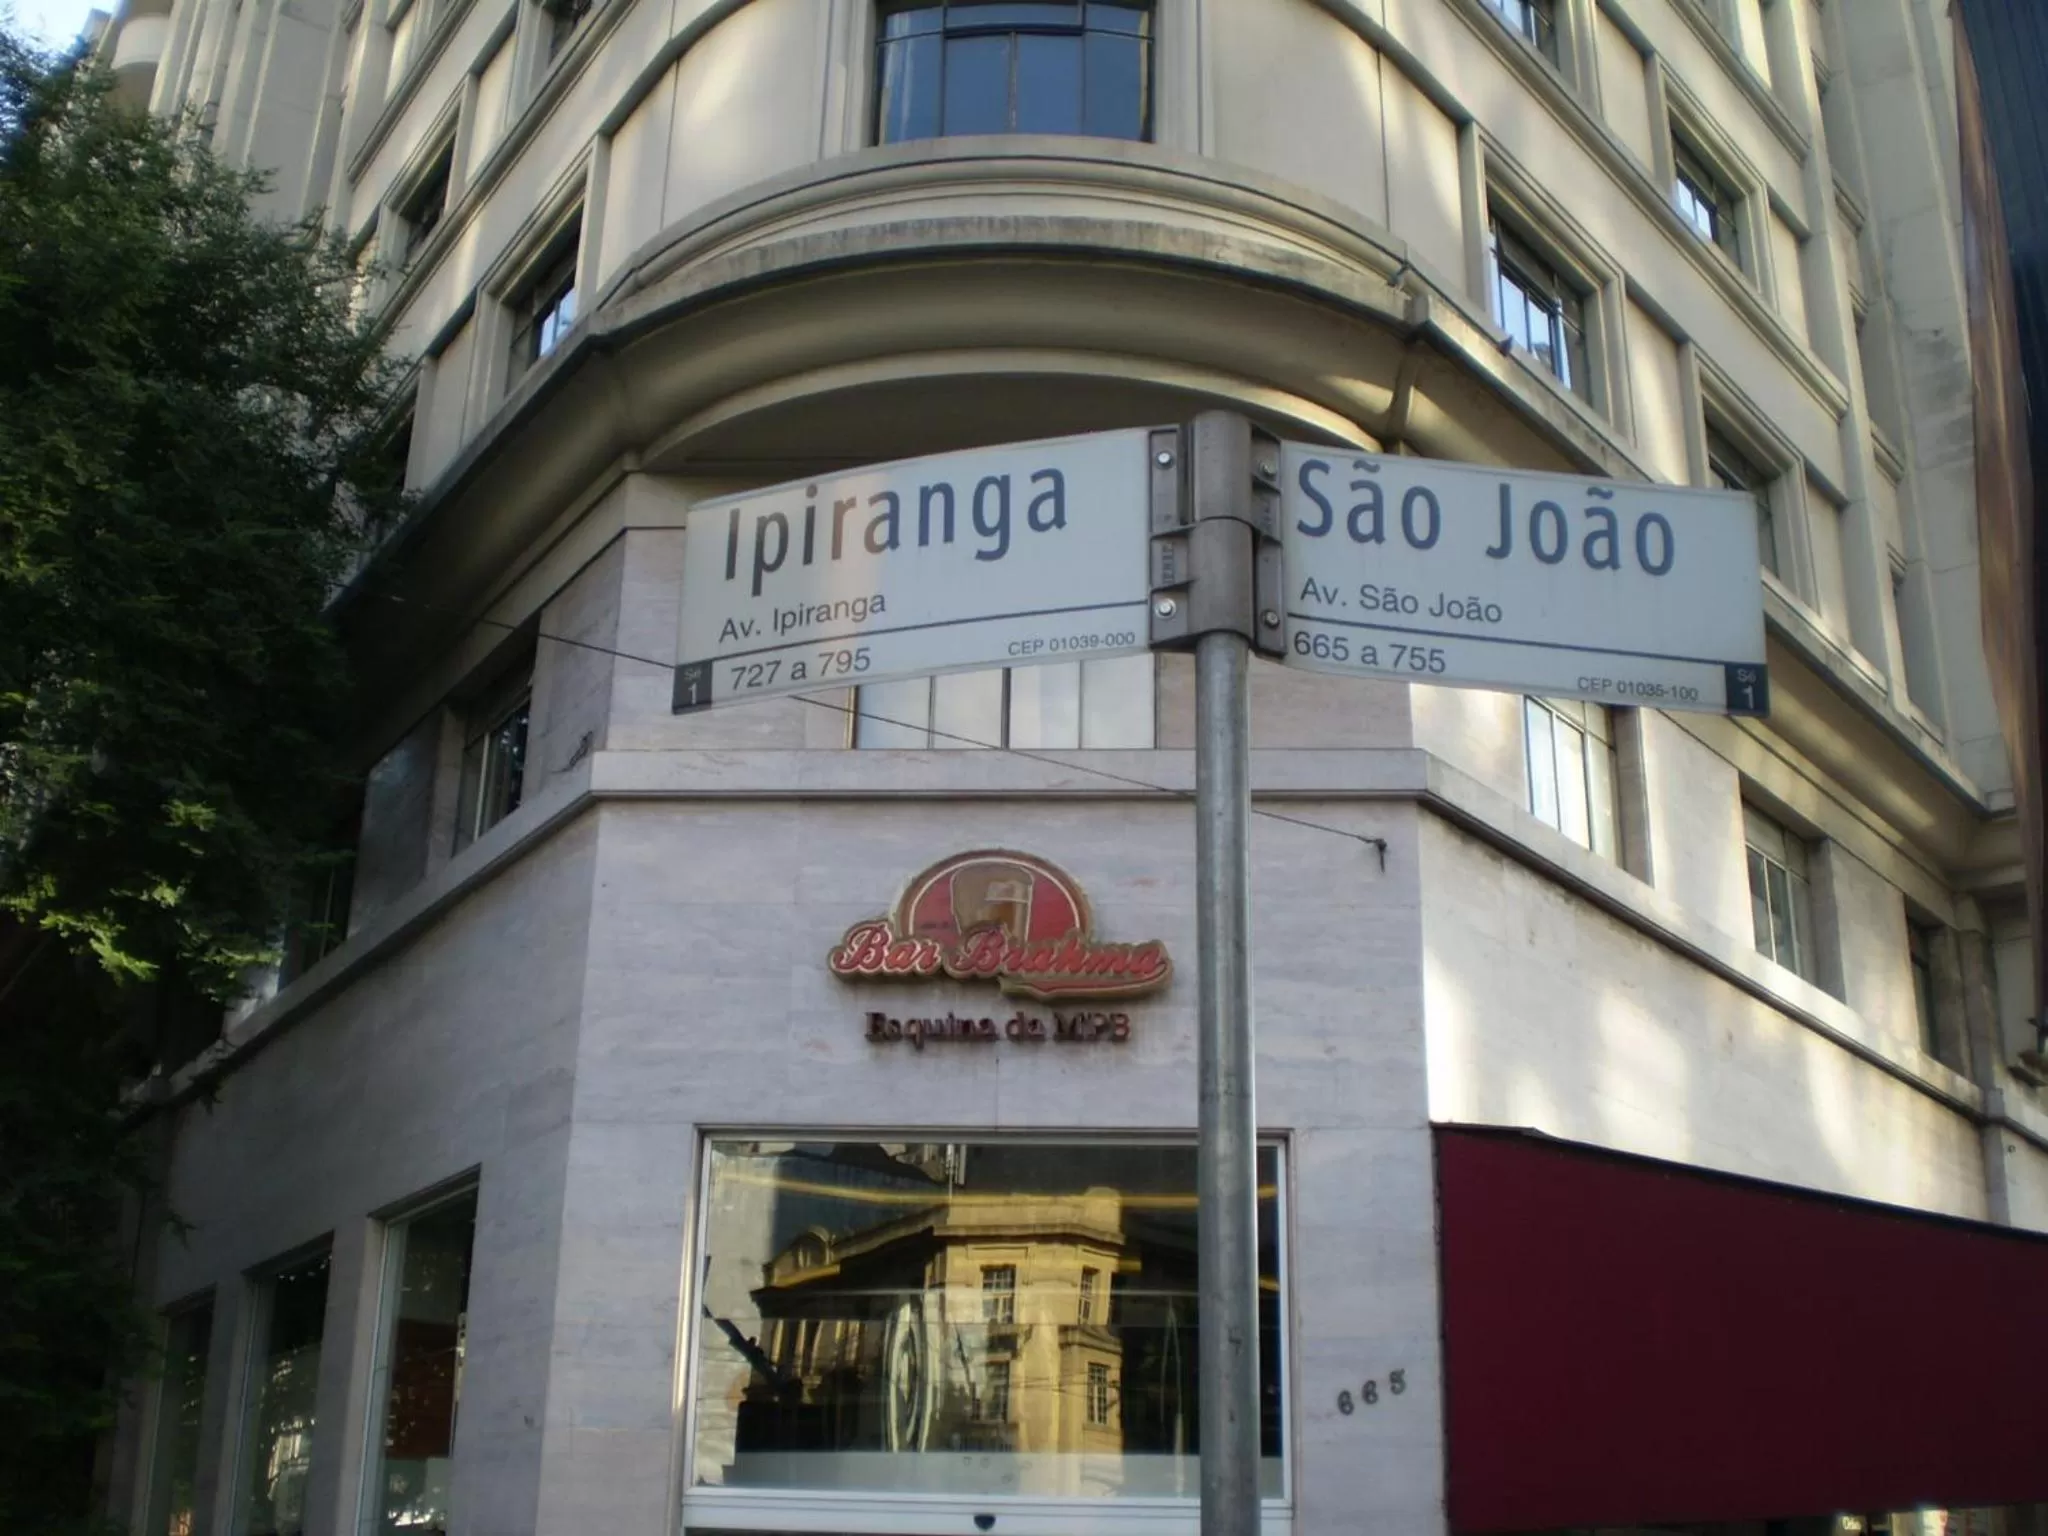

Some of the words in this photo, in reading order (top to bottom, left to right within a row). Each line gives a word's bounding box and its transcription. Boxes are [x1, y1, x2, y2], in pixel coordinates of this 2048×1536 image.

[724, 468, 1068, 596] Ipiranga
[1297, 459, 1442, 550] São
[1486, 483, 1676, 577] João
[718, 617, 761, 643] Av.
[773, 592, 887, 637] Ipiranga
[1300, 577, 1346, 606] Av.
[1359, 583, 1419, 615] São
[1429, 593, 1503, 624] João
[1008, 638, 1044, 656] CEP
[1049, 631, 1136, 652] 01039-000
[1293, 630, 1349, 662] 665
[1360, 647, 1378, 666] a
[1389, 643, 1447, 674] 755
[731, 660, 783, 691] 727
[790, 662, 807, 682] a
[819, 647, 872, 675] 795
[1577, 676, 1612, 692] CEP
[1616, 679, 1699, 701] 01035-100
[688, 683, 697, 705] 1
[1742, 684, 1754, 709] 1
[831, 921, 942, 975] Bar
[947, 926, 1169, 990] Brahma
[865, 1012, 998, 1050] Esquina
[1005, 1011, 1046, 1042] da
[1053, 1012, 1131, 1042] MPB
[1337, 1368, 1406, 1416] 665
